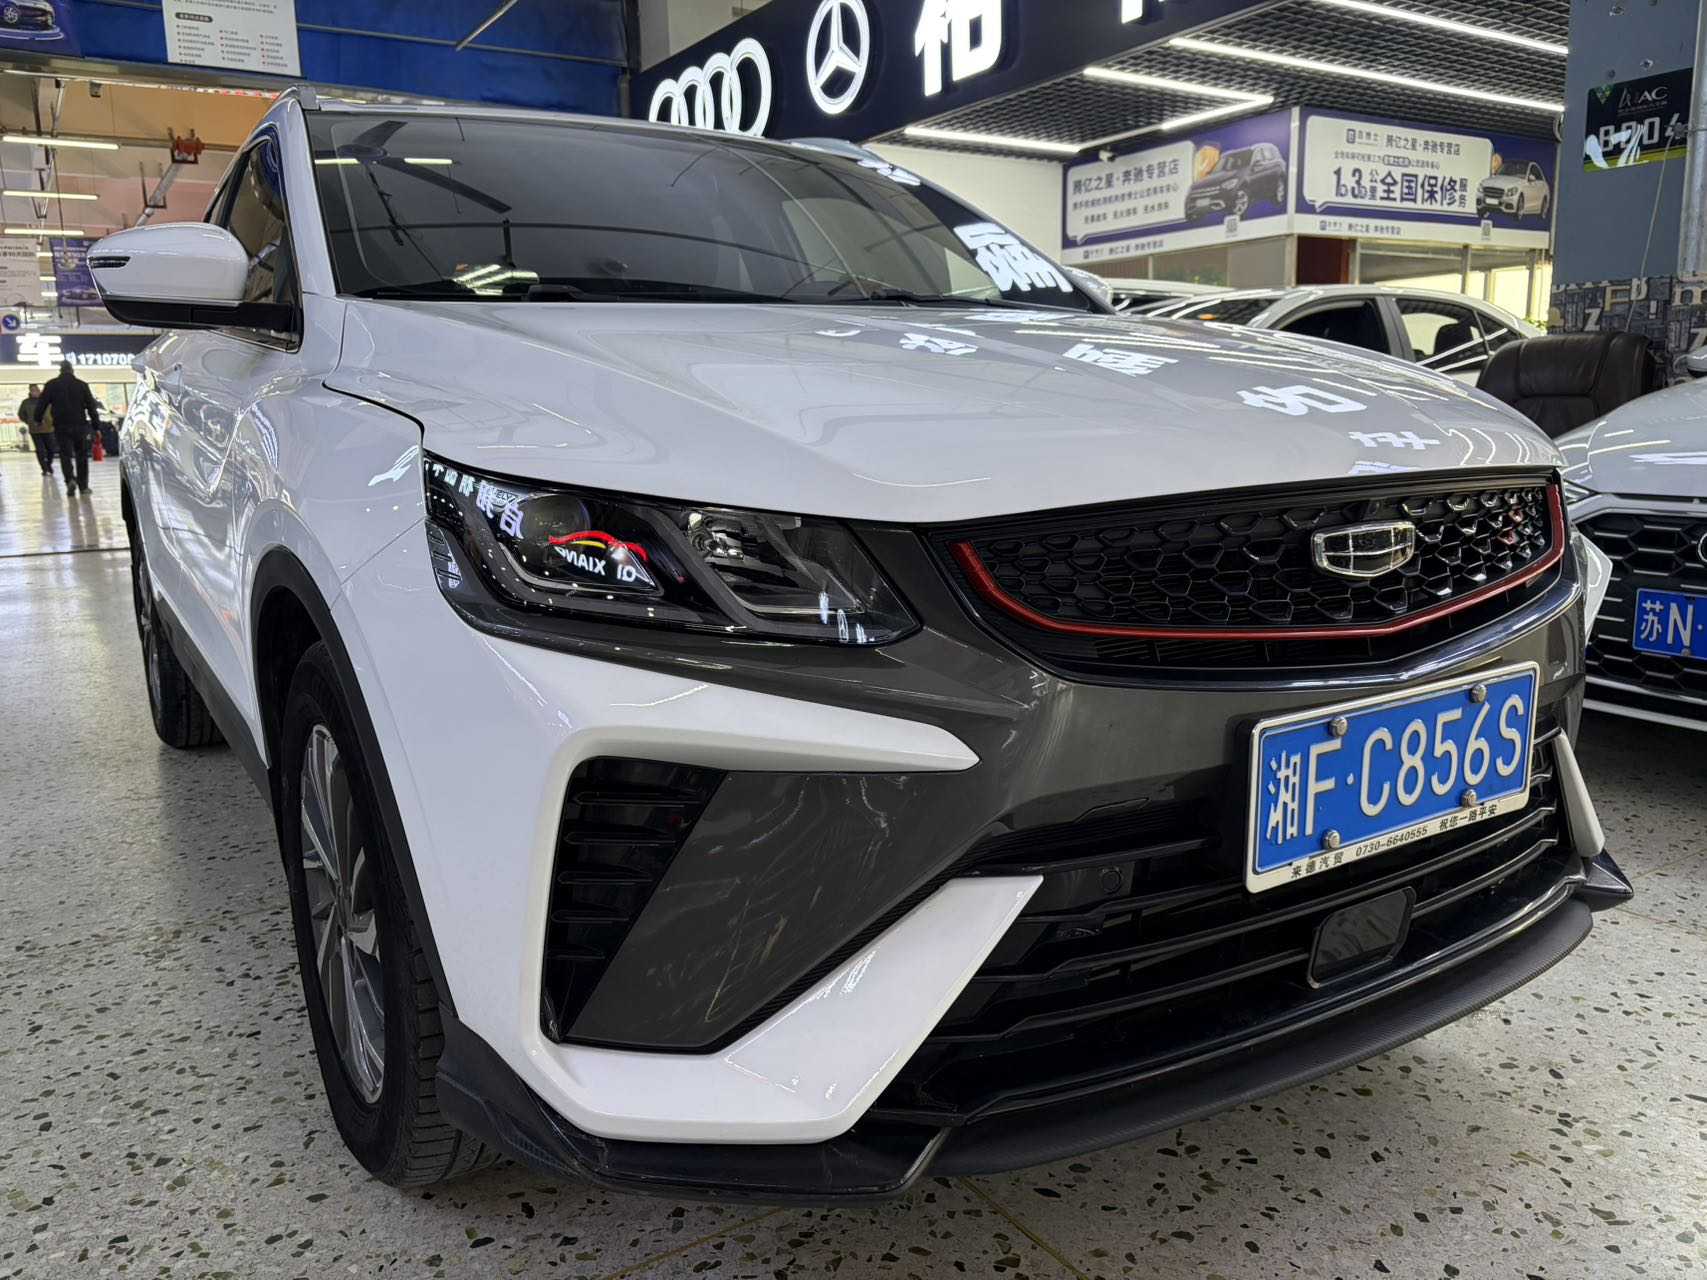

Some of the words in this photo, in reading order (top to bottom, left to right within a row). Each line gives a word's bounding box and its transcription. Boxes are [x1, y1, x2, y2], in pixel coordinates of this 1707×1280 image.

[1265, 694, 1526, 845] 湘F·C856S
[1439, 804, 1499, 831] 祝您一路平安
[1355, 825, 1429, 857] 0730-6640555
